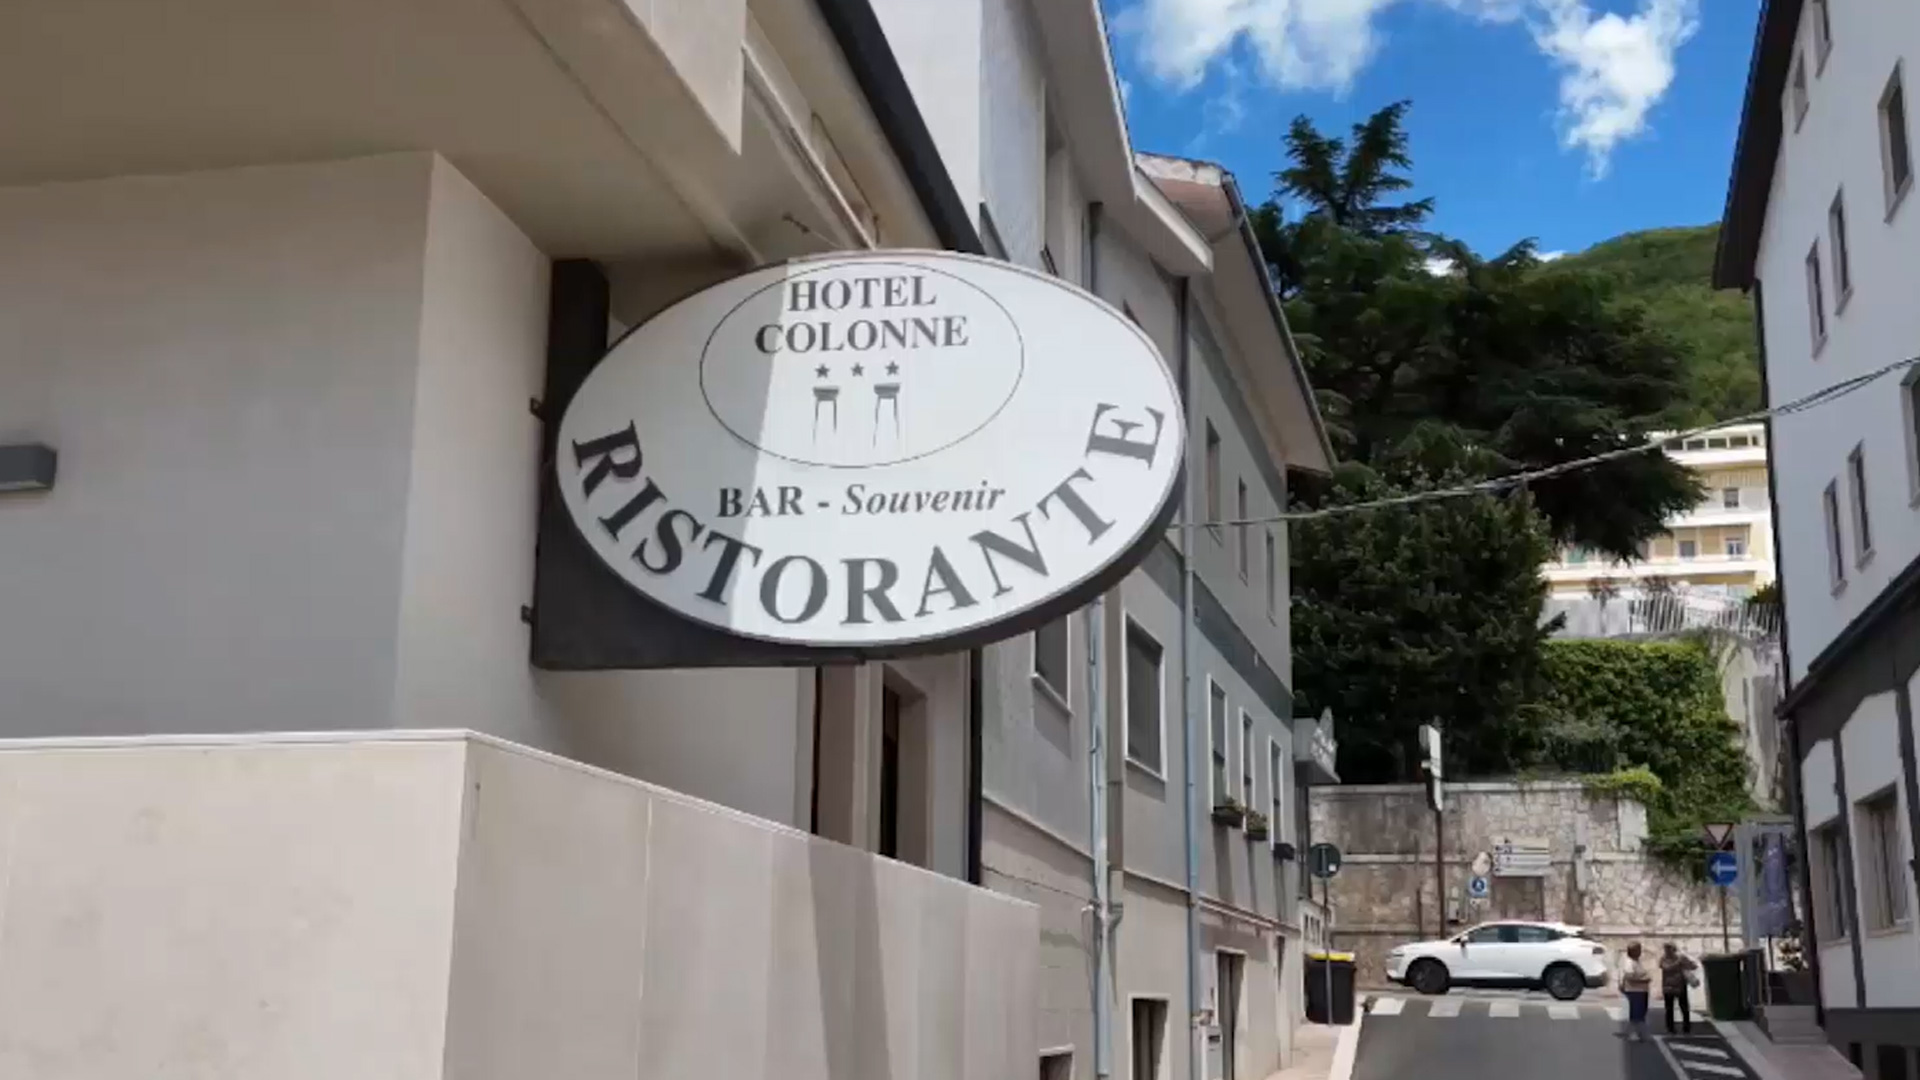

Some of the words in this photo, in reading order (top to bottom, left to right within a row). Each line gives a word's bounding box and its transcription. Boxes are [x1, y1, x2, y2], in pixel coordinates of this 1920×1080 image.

[789, 275, 937, 312] HOTEL
[755, 316, 969, 354] COLONNE
[572, 402, 1166, 625] RISTORANTE
[717, 485, 805, 518] BAR
[842, 480, 1006, 515] Souvenir
